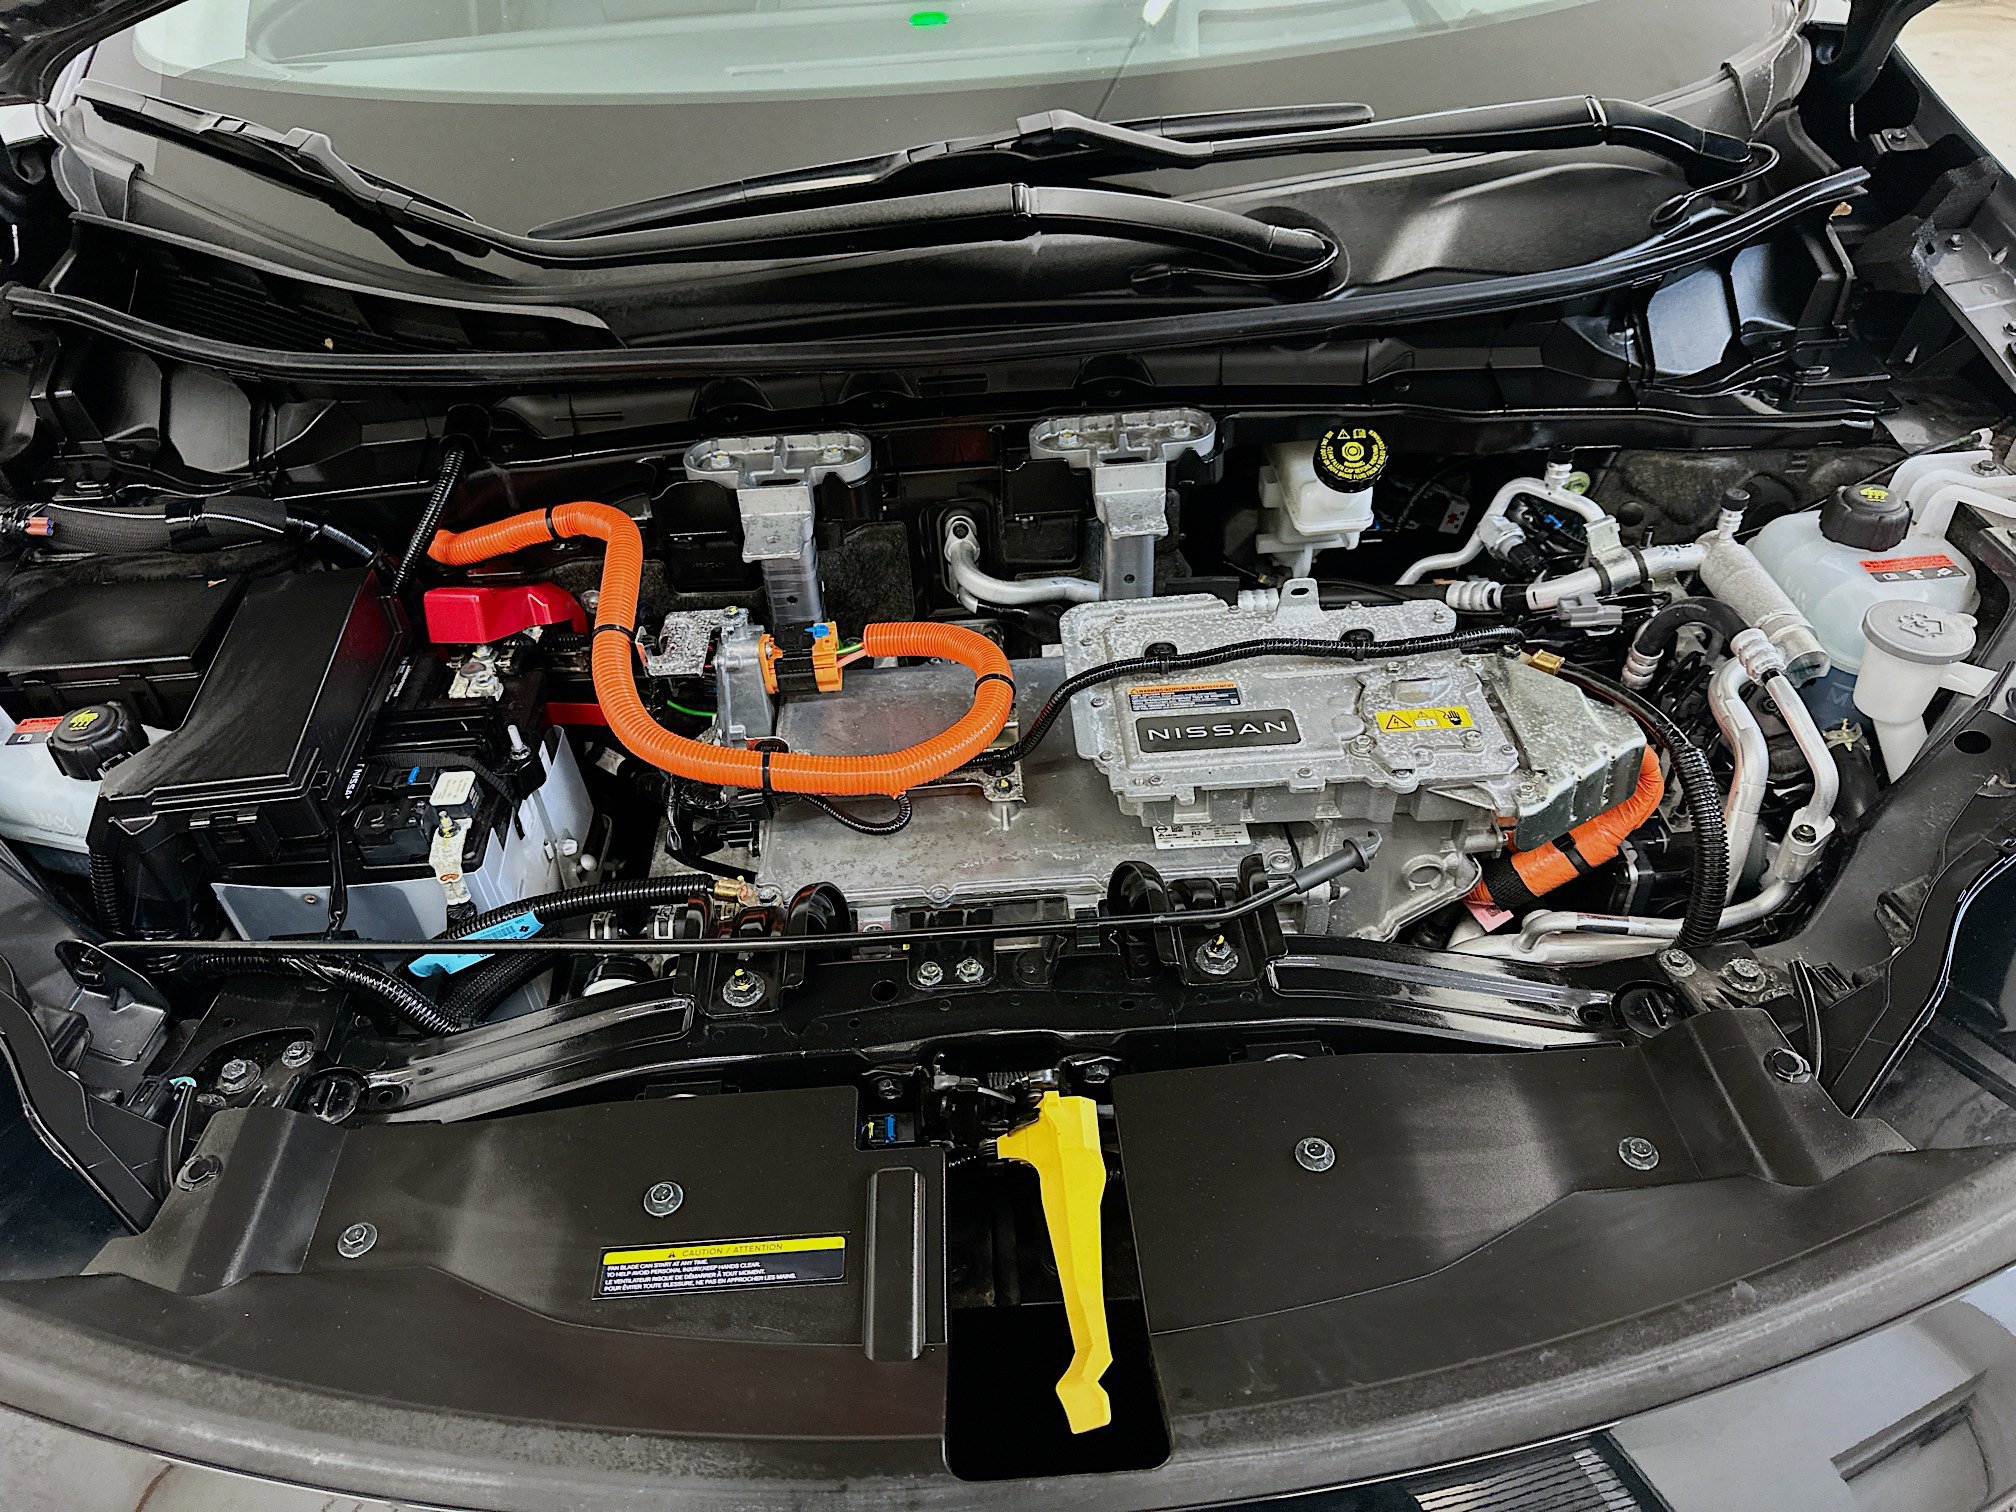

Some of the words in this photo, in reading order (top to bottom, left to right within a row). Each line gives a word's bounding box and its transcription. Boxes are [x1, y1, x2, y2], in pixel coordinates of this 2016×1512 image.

[1148, 720, 1288, 741] NISSAN
[683, 1248, 722, 1256] CAUTION
[734, 1244, 783, 1253] ATTENTION
